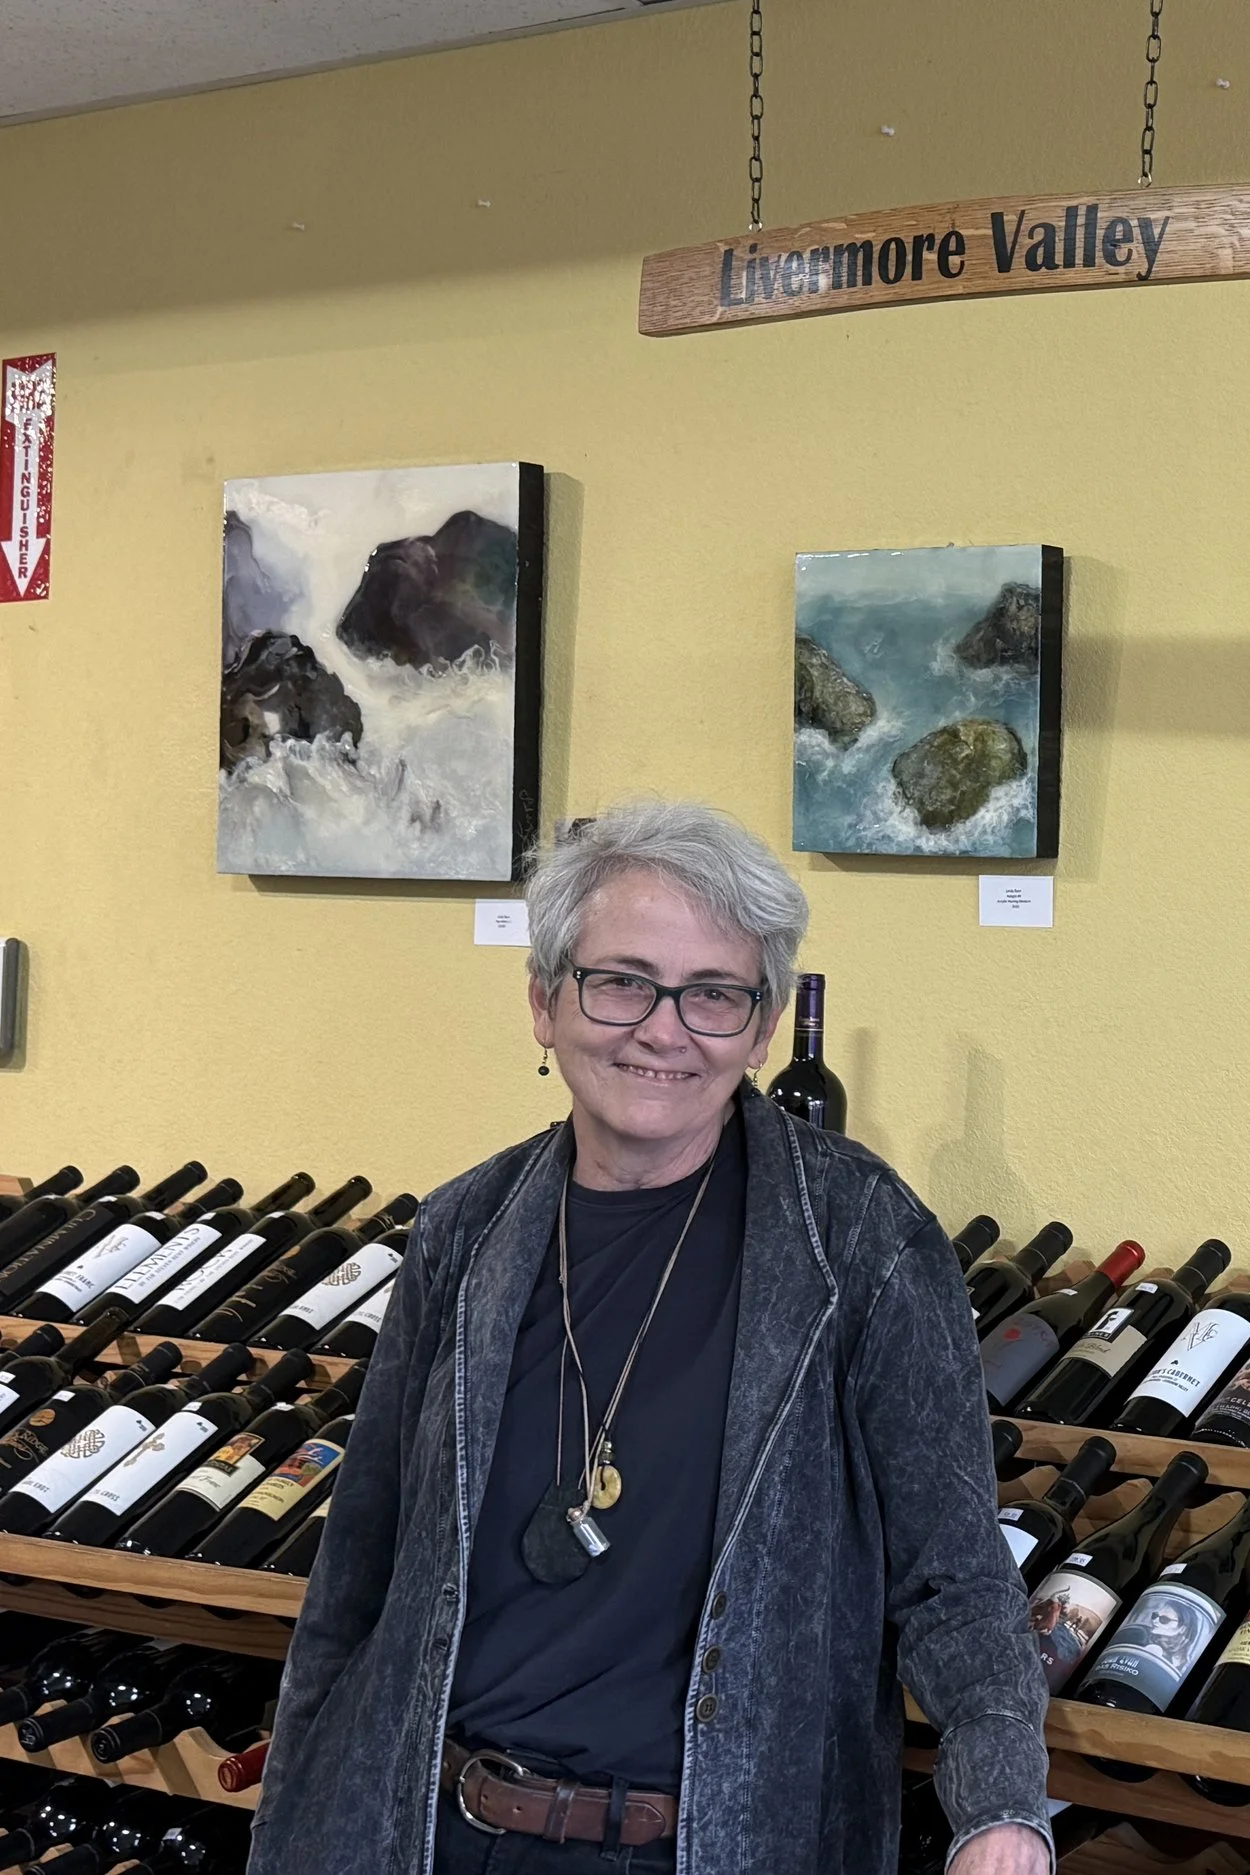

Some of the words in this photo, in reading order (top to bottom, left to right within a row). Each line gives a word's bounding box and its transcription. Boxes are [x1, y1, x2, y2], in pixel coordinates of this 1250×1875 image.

[718, 228, 966, 309] Livermore
[990, 202, 1171, 281] Valley
[17, 418, 33, 580] EXTINGUISHER
[114, 1226, 201, 1291] ELEMENTS
[1167, 1367, 1201, 1388] CABERNET
